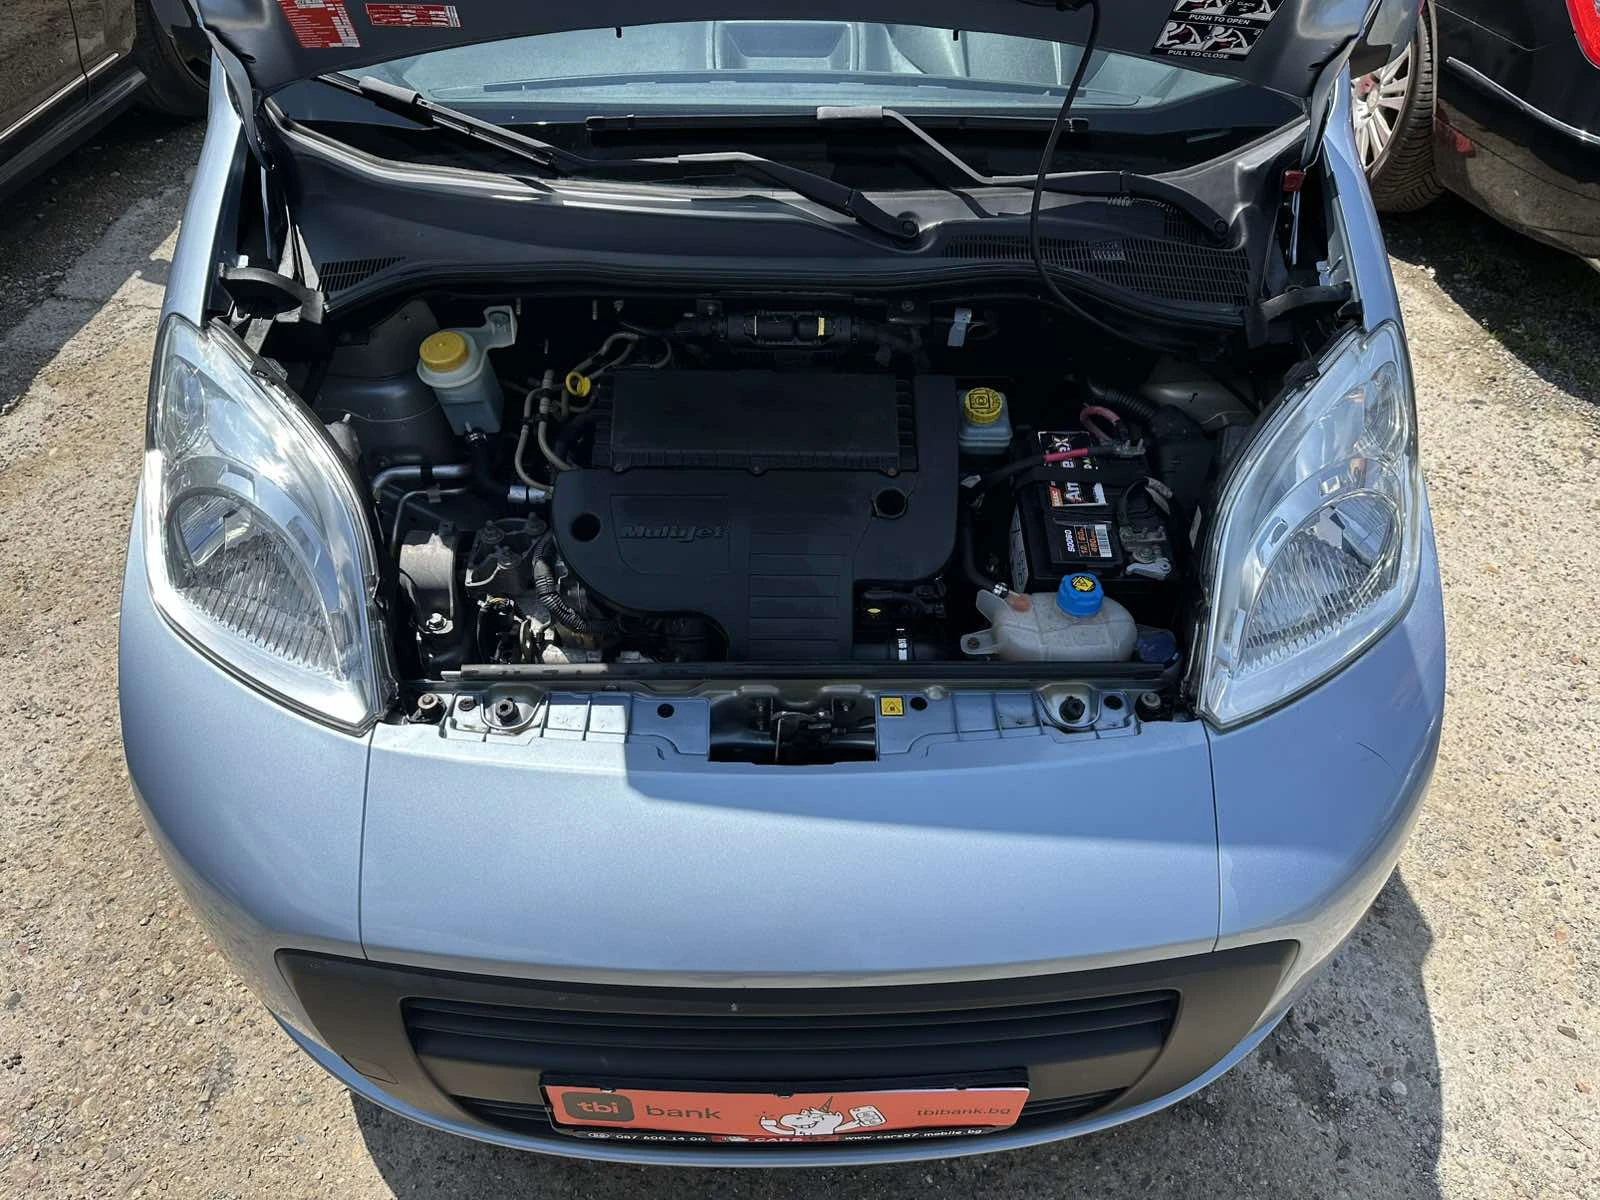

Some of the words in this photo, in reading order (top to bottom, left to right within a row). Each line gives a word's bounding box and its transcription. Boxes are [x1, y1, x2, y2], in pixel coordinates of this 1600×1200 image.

[1226, 17, 1250, 25] OPEN
[1167, 49, 1188, 57] PULL
[1202, 52, 1230, 60] CLOSE
[577, 1101, 621, 1114] tbi
[645, 1104, 721, 1120] bank
[916, 1106, 1011, 1117] tbibank.bg
